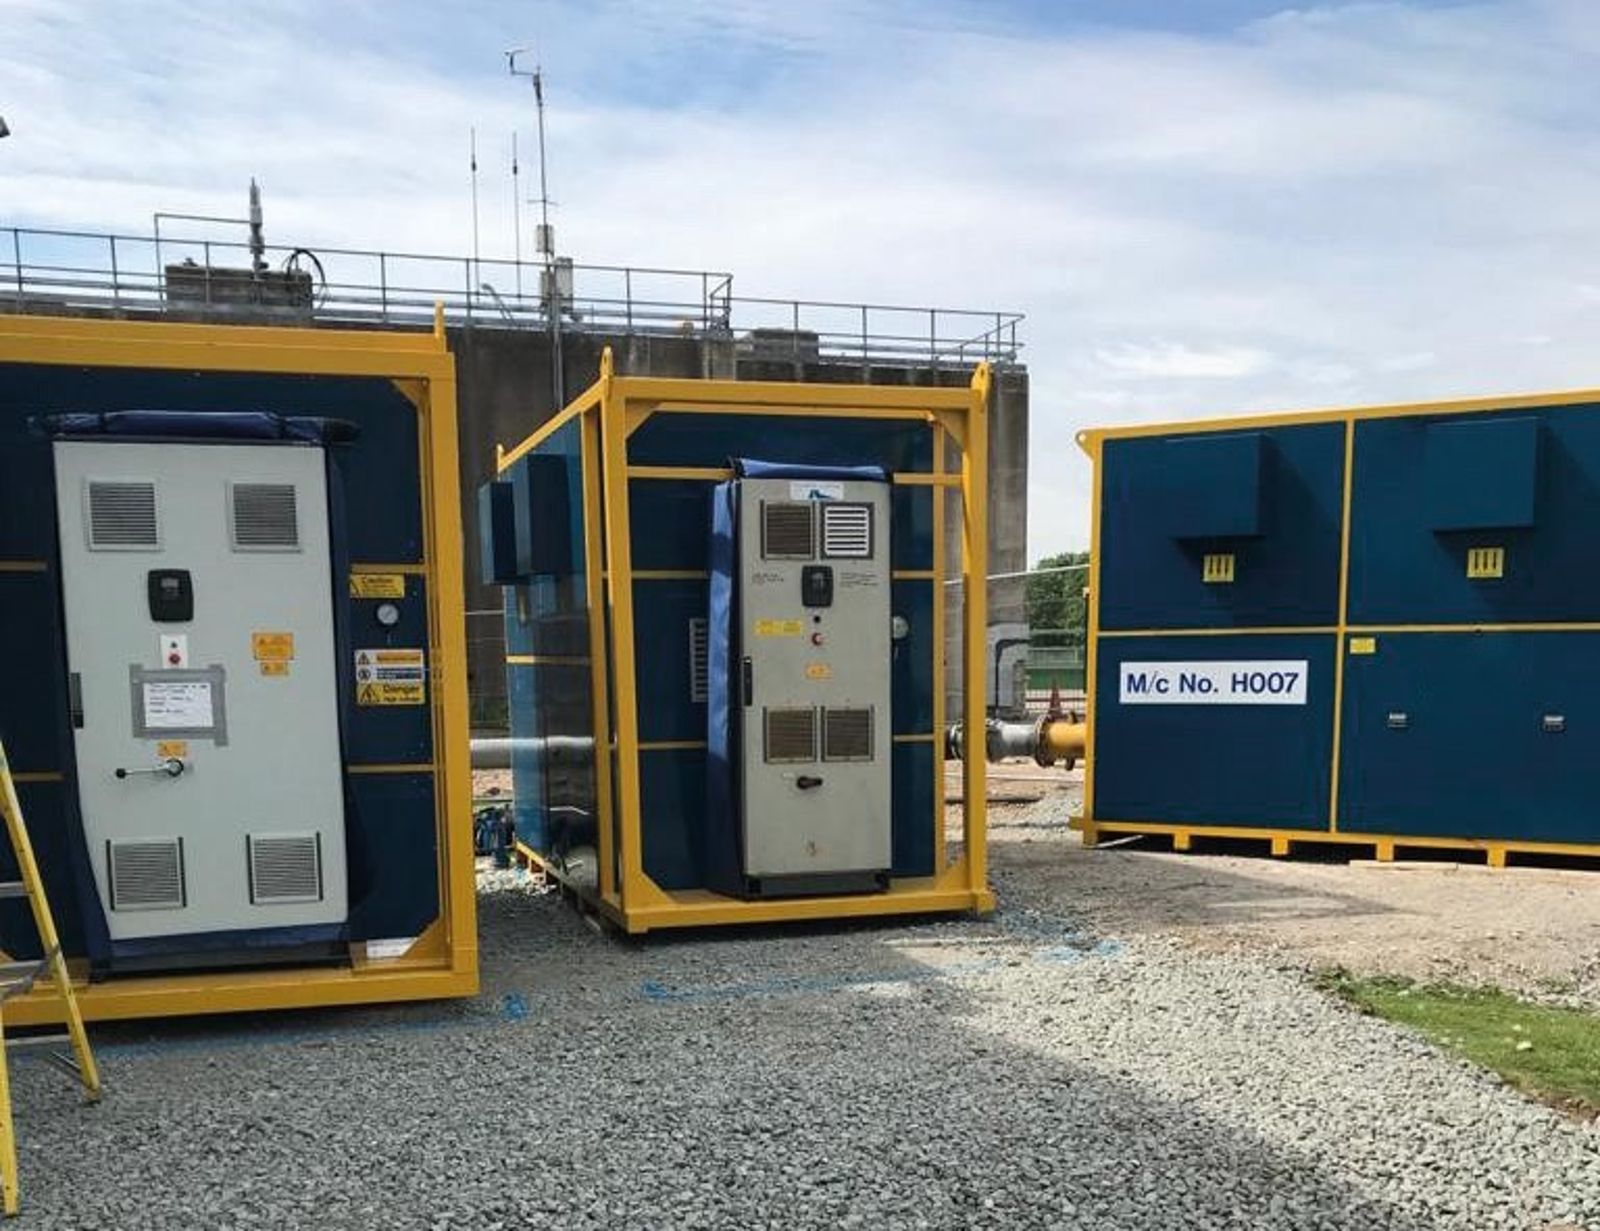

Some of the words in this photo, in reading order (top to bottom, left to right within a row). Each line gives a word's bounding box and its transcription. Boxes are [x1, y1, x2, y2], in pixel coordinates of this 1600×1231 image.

[1126, 671, 1169, 694] M/c
[1179, 673, 1219, 694] No.
[1231, 672, 1299, 694] H007
